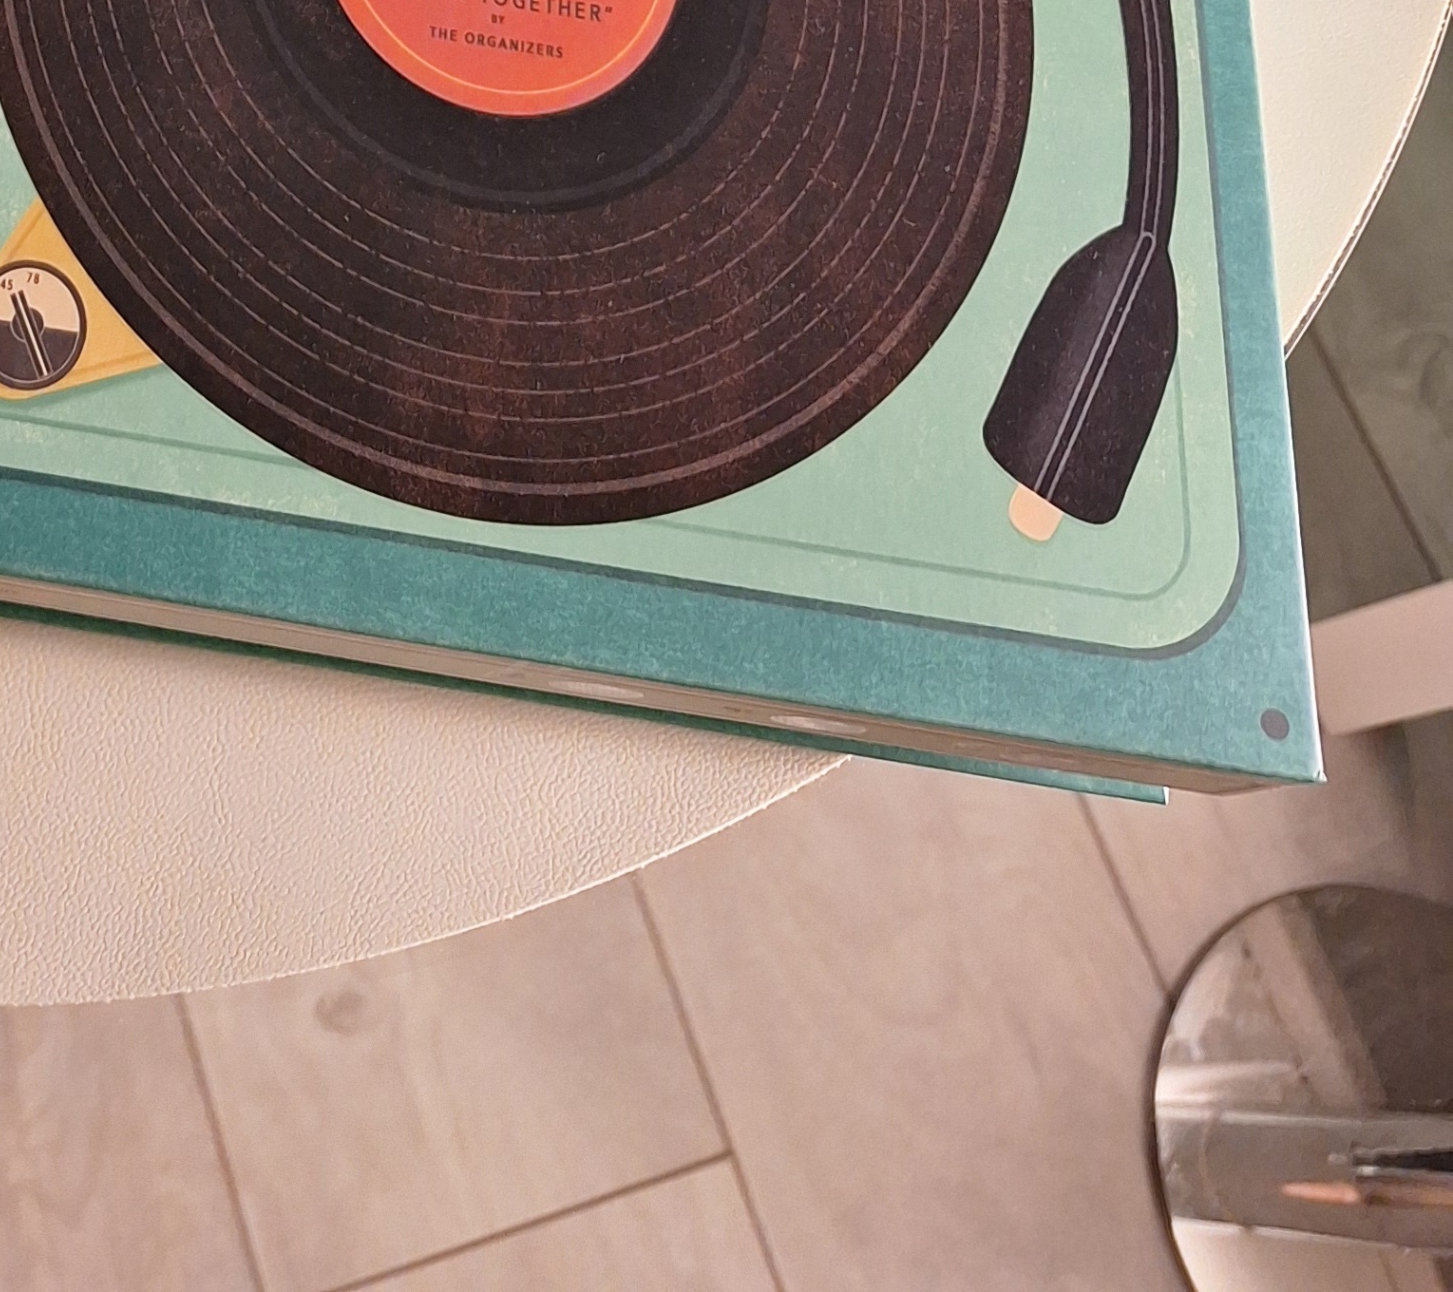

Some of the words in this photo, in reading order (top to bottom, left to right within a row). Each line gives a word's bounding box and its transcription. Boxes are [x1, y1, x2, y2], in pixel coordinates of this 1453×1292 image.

[491, 13, 505, 24] BY
[429, 25, 458, 42] THE
[464, 31, 564, 59] ORGANIZERS
[0, 278, 14, 291] 45
[26, 271, 40, 285] 78
